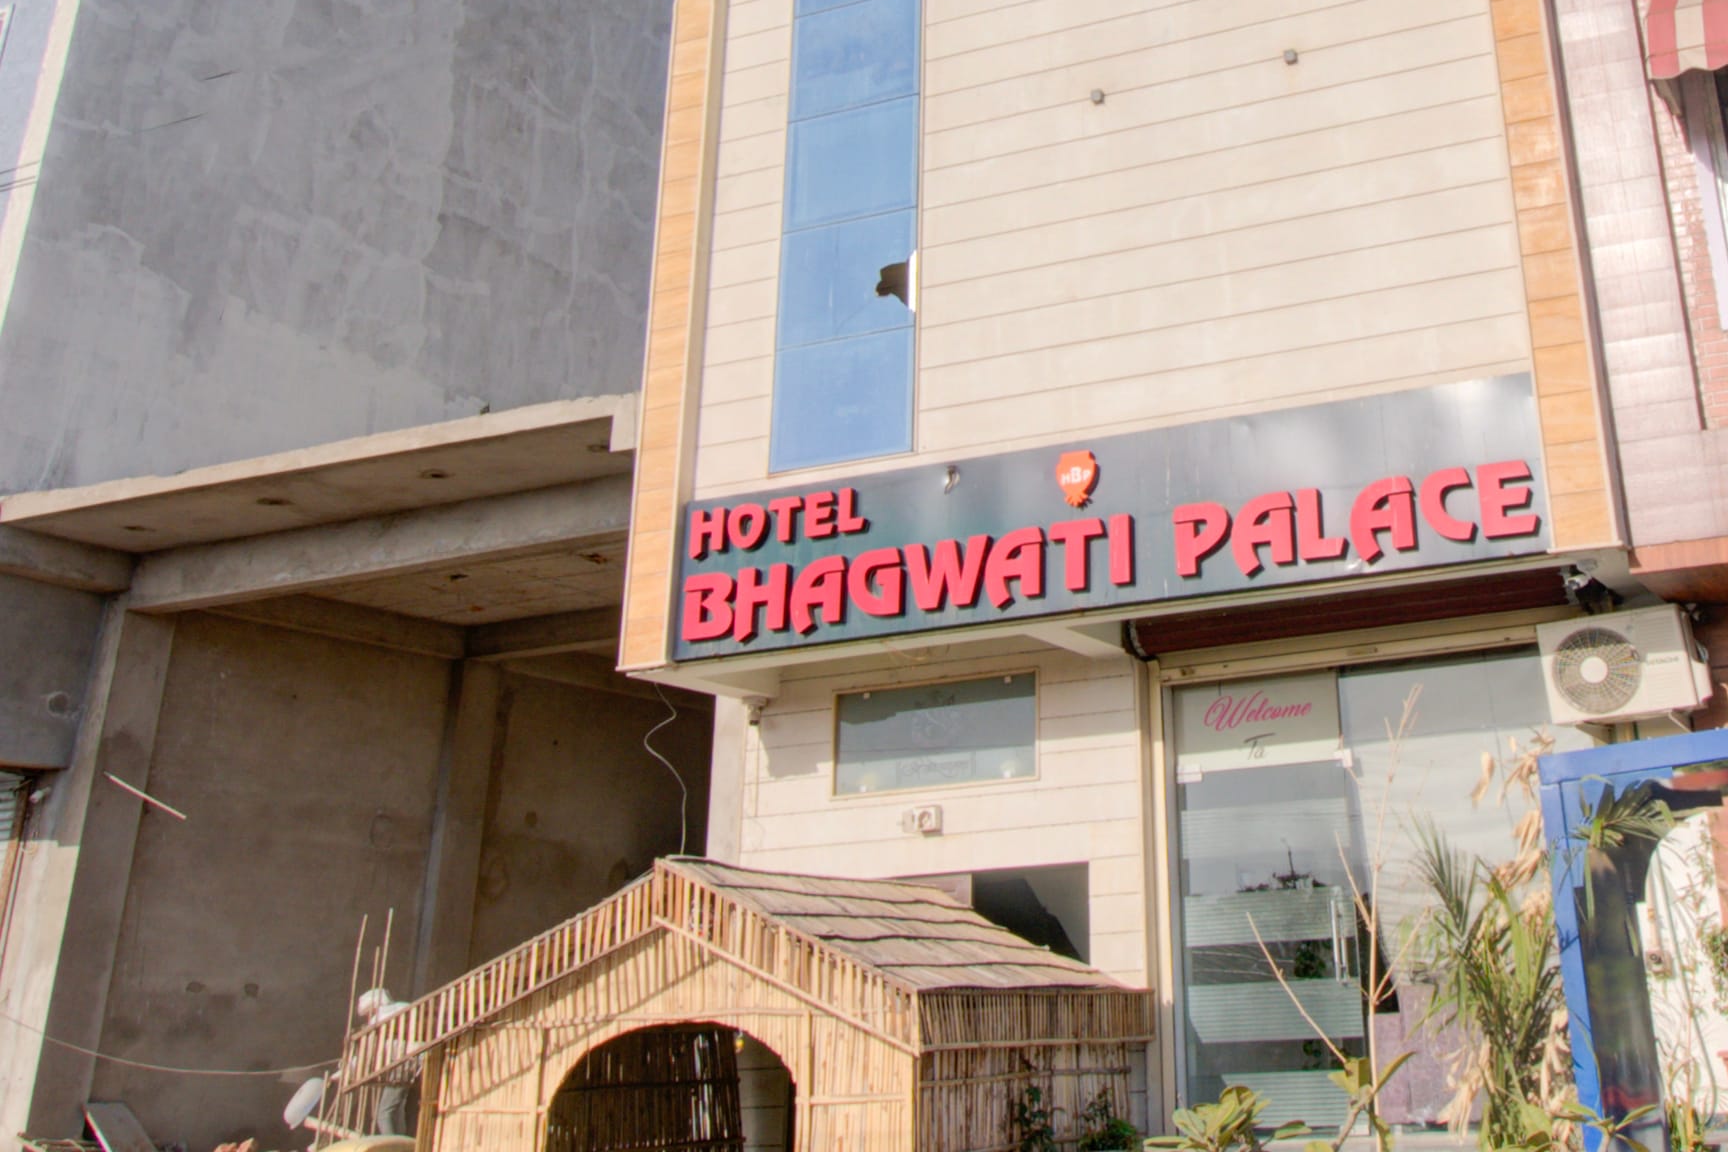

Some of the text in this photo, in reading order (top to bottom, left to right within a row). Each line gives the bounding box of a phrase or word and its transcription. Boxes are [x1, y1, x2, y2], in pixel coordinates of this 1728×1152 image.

[679, 459, 1543, 644] BHAGWATI PALACE
[688, 486, 868, 562] HOTEL
[1203, 689, 1312, 732] Welcome
